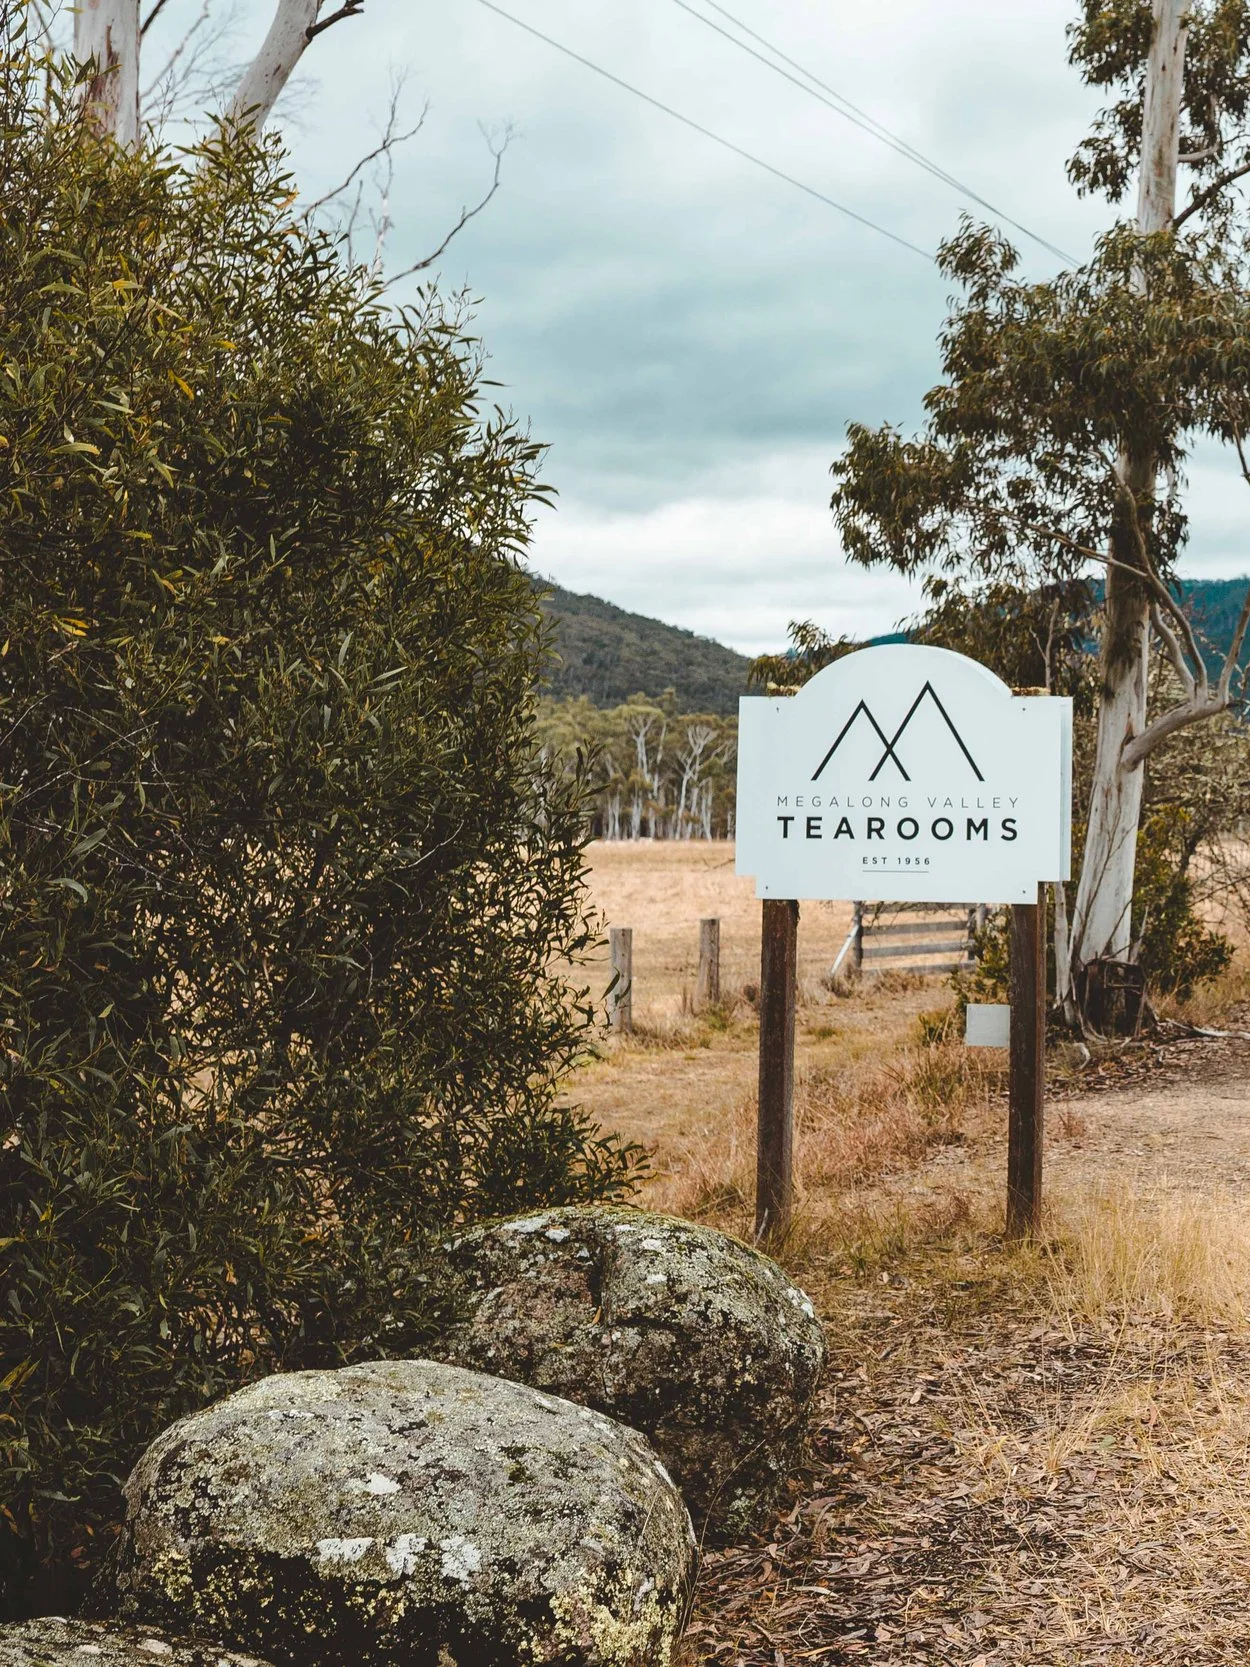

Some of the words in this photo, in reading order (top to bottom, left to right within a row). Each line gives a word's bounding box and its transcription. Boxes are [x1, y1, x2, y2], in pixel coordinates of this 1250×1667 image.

[777, 796, 909, 808] MEGALONG
[927, 797, 1019, 809] VALLEY
[777, 816, 1018, 841] TEAROOMS
[862, 856, 888, 865] EST
[897, 857, 930, 866] 1956
